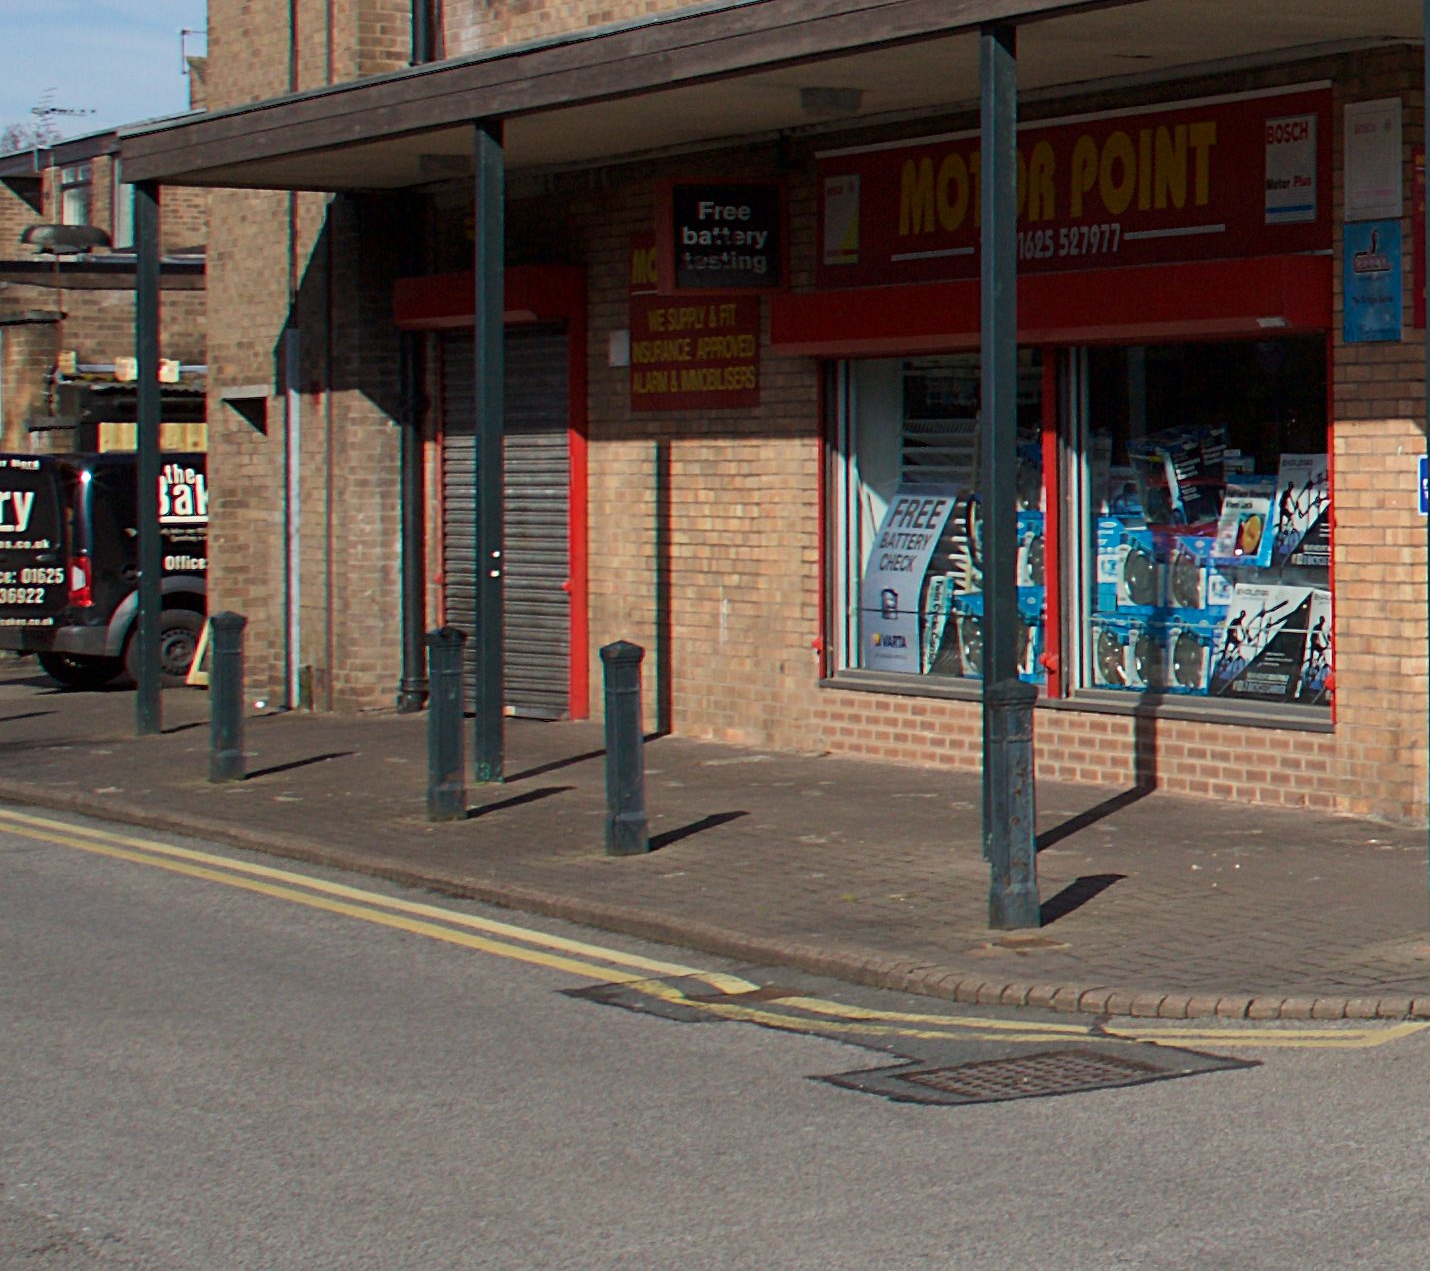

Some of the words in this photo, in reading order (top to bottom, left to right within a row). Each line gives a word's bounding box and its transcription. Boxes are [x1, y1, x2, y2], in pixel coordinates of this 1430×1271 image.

[1266, 122, 1310, 145] BOSCH
[900, 139, 1056, 236] MOR
[1070, 121, 1218, 219] POINT
[698, 201, 752, 222] Free
[682, 225, 769, 249] battery
[1017, 227, 1055, 259] 1625
[1059, 223, 1121, 254] 527977
[163, 463, 196, 485] the
[888, 498, 946, 530] FREE
[879, 532, 933, 551] BATTERY
[879, 553, 918, 572] CHECK
[20, 568, 65, 584] 01625
[881, 634, 907, 649] VARTA
